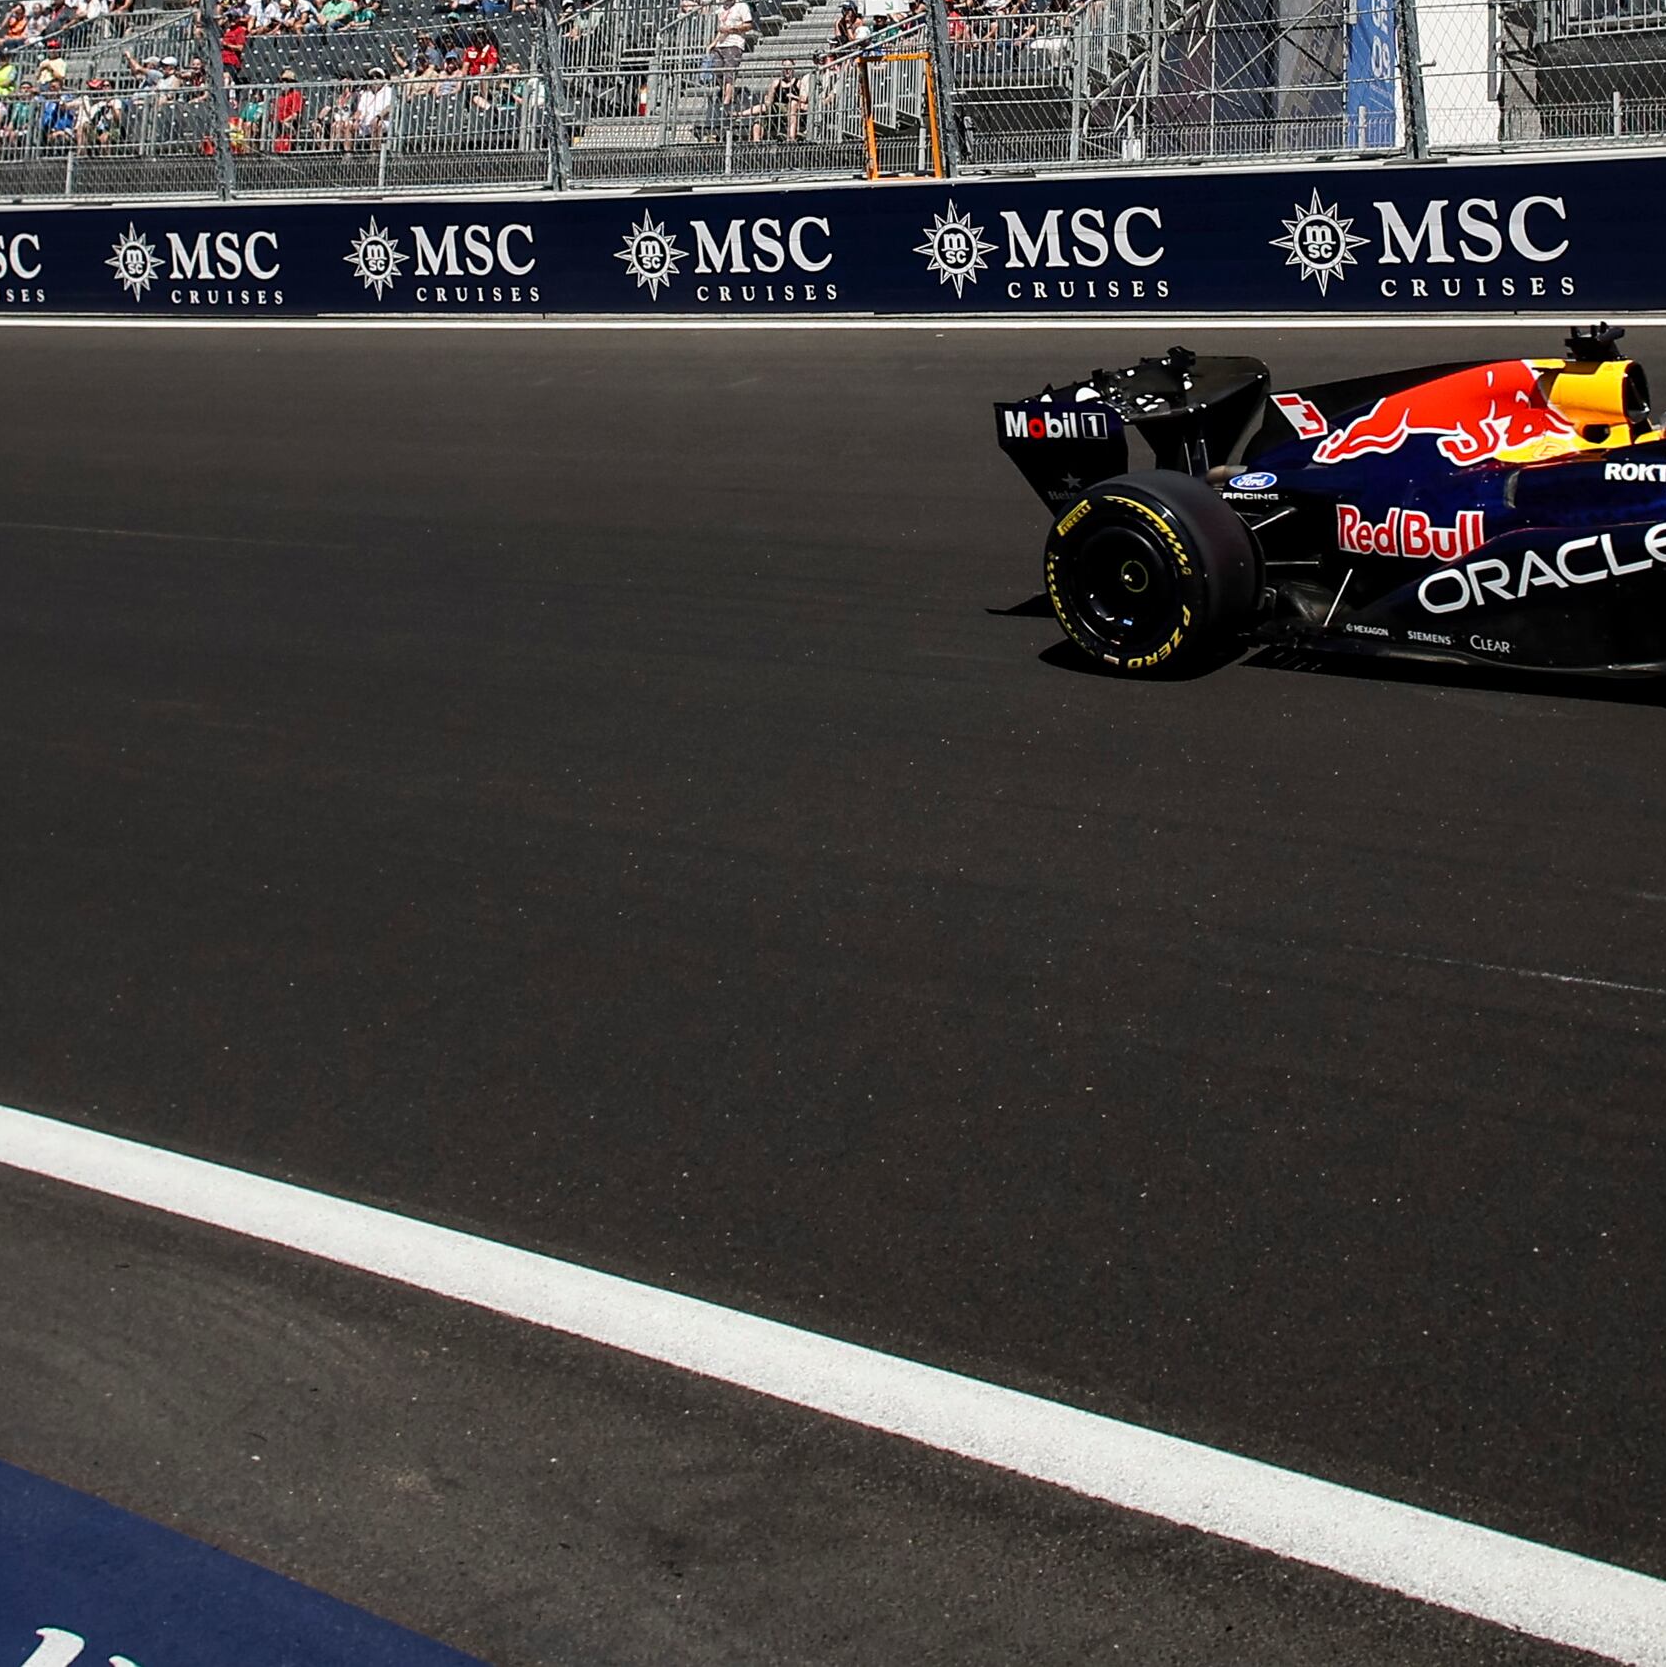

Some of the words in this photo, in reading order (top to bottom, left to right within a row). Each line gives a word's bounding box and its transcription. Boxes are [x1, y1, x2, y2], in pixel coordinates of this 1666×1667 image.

[1000, 207, 1165, 268] MSC
[1373, 196, 1569, 263] MSC
[410, 224, 536, 275] MSC
[690, 217, 833, 273] MSC
[166, 231, 280, 279] MSC
[417, 287, 540, 301] CRUISES
[697, 284, 837, 301] CRUISES
[1008, 281, 1169, 298] CRUISES
[1381, 277, 1575, 296] CRUISES
[172, 290, 283, 304] CRUISES
[1004, 411, 1079, 440] Mobil
[1236, 474, 1269, 487] Ford
[1222, 492, 1279, 501] RACING
[1336, 503, 1400, 557] Red
[1400, 509, 1484, 562] Bull
[1353, 626, 1389, 637] HEXAGON
[1407, 630, 1452, 646] SIEMENS
[1127, 626, 1183, 669] ZERO
